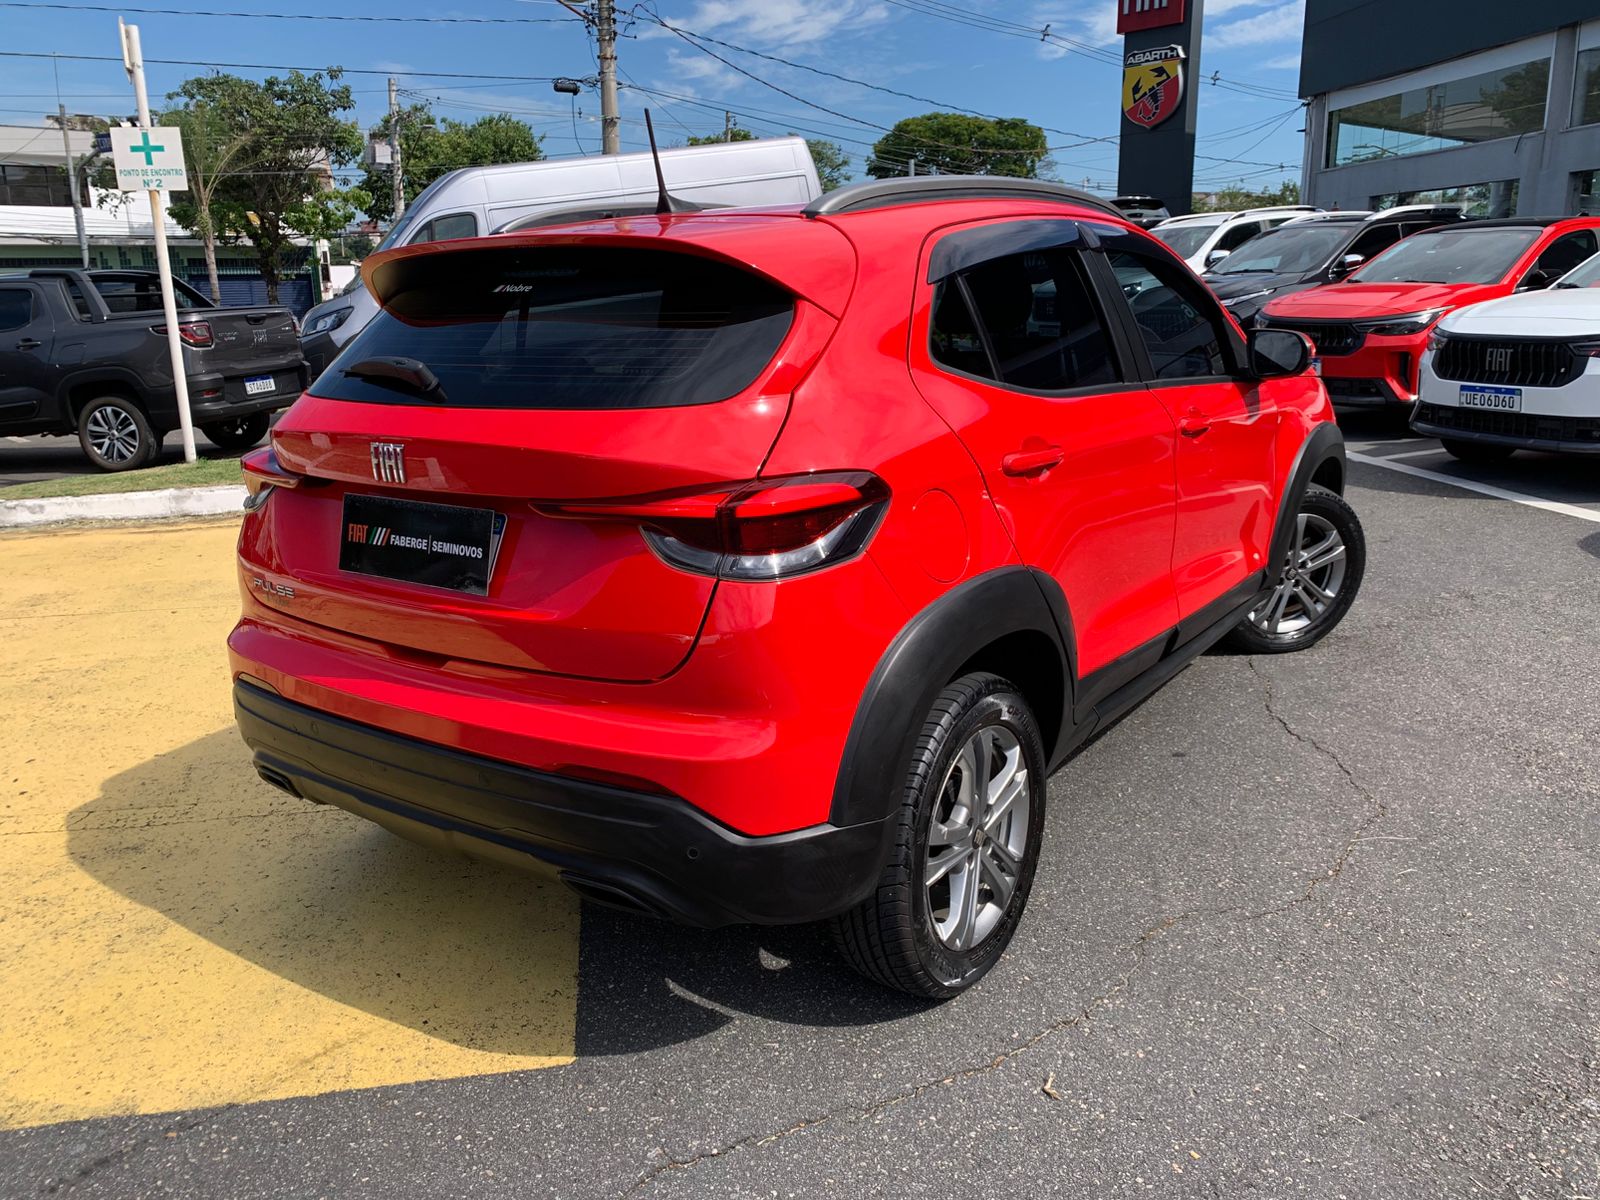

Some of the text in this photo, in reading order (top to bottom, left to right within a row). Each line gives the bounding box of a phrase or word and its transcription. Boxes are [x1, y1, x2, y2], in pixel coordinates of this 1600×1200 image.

[1126, 49, 1177, 65] ABARTH
[119, 169, 139, 177] PONTO
[150, 168, 183, 176] ENCONTRO
[155, 179, 163, 188] 2
[502, 283, 533, 293] Nobre
[1485, 347, 1514, 372] FIAT
[370, 442, 406, 484] FIAT
[348, 523, 483, 559] FIAT FABERGE SEMINOVOS
[253, 576, 296, 599] PULSE
